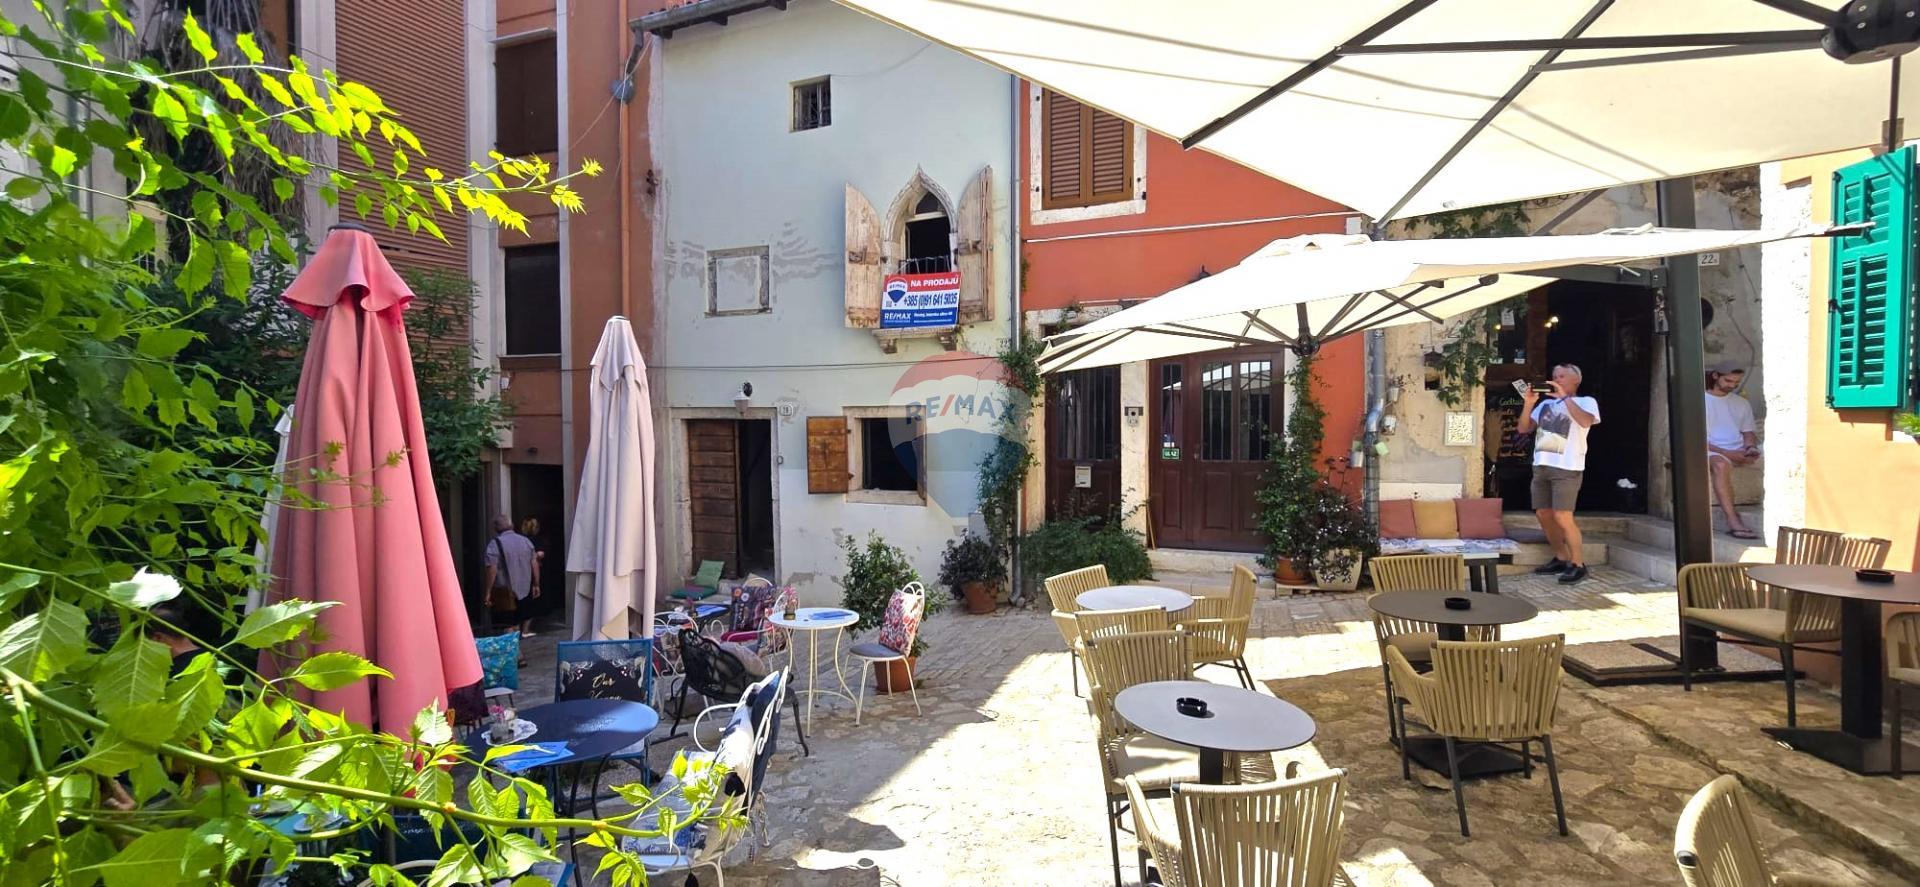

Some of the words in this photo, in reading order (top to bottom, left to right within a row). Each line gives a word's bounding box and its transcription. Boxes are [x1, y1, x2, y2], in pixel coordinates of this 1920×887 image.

[910, 279, 921, 287] NA
[923, 277, 959, 286] PRODAJU
[904, 294, 918, 306] +385
[884, 312, 911, 320] RE/MAX
